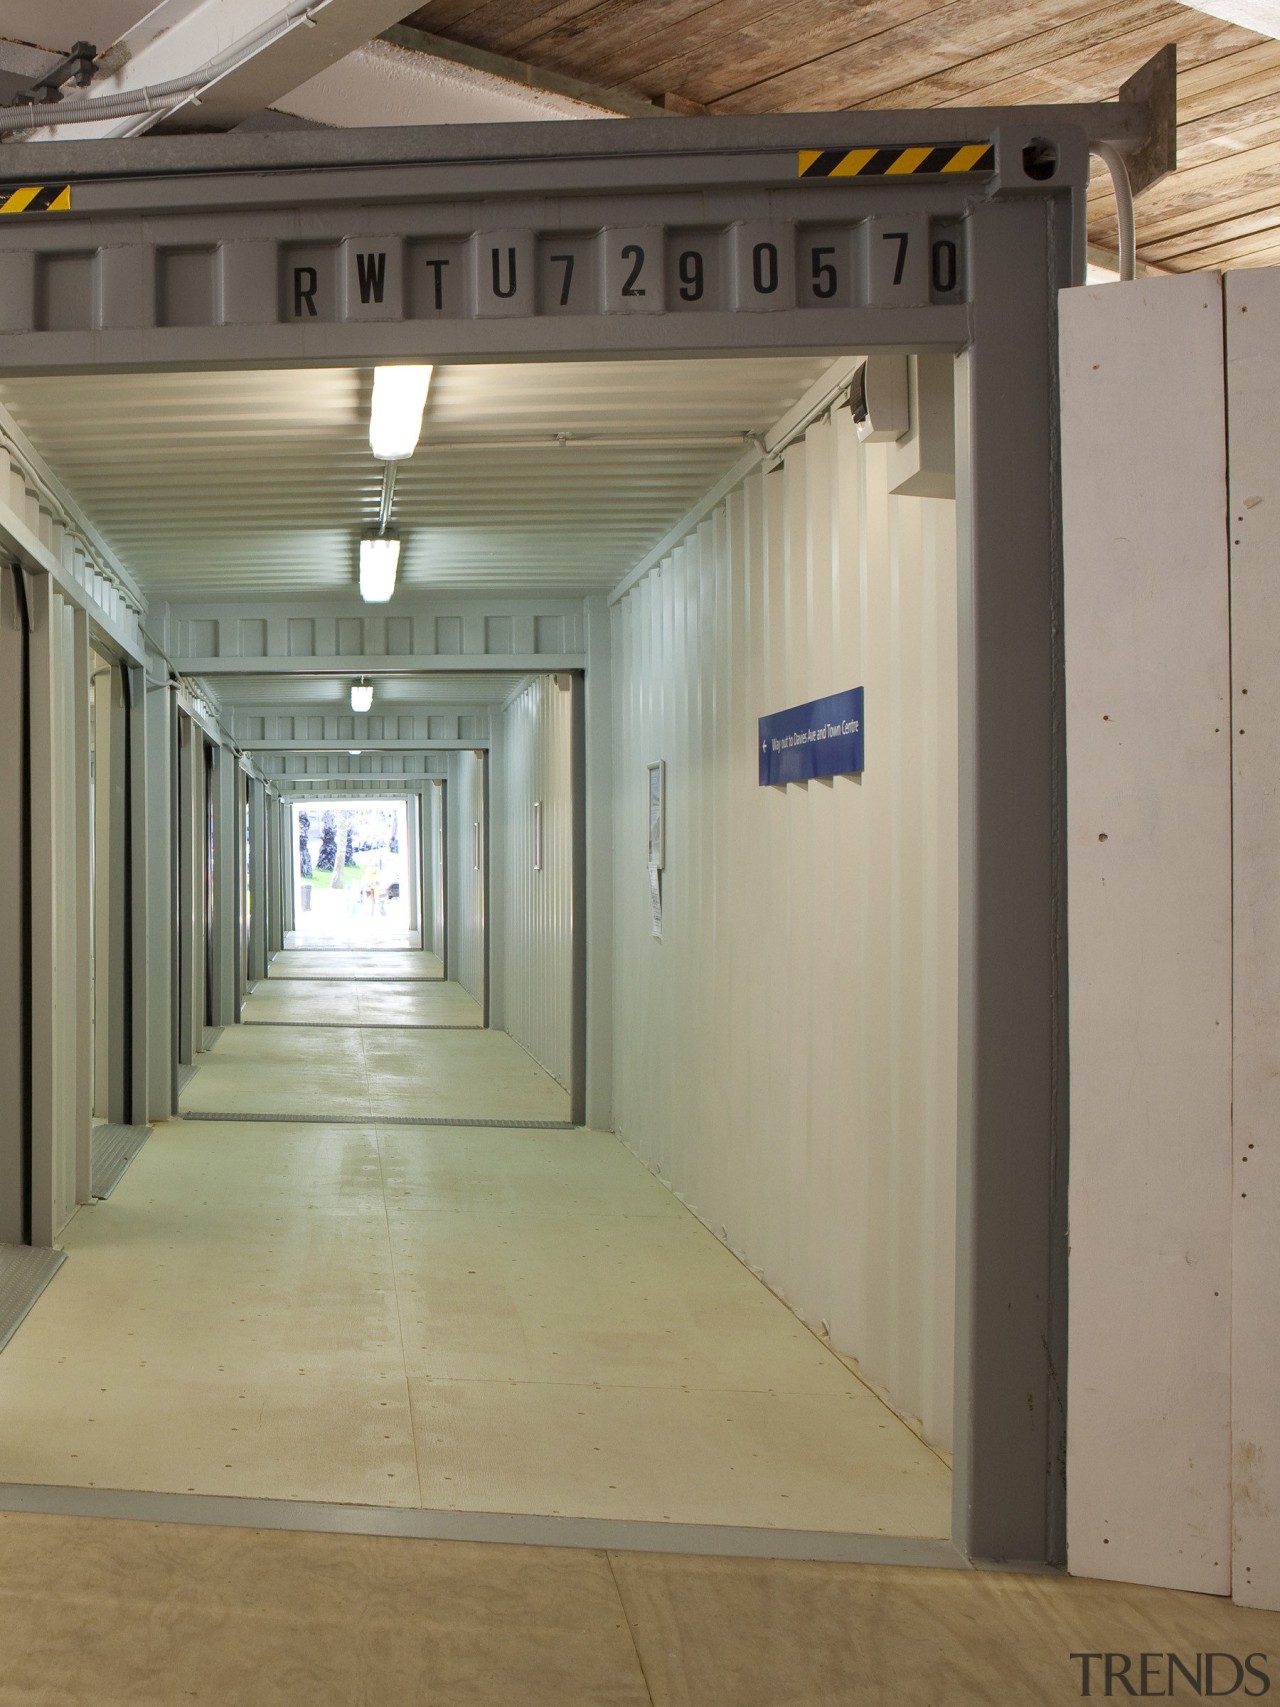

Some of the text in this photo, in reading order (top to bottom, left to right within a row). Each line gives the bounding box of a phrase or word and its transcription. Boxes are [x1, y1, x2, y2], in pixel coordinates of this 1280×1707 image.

[771, 738, 780, 753] Way
[788, 736, 794, 747] to
[794, 730, 807, 745] Davies
[807, 729, 816, 742] Ave
[817, 724, 826, 740] and
[827, 724, 841, 737] Town
[842, 720, 859, 735] Centre
